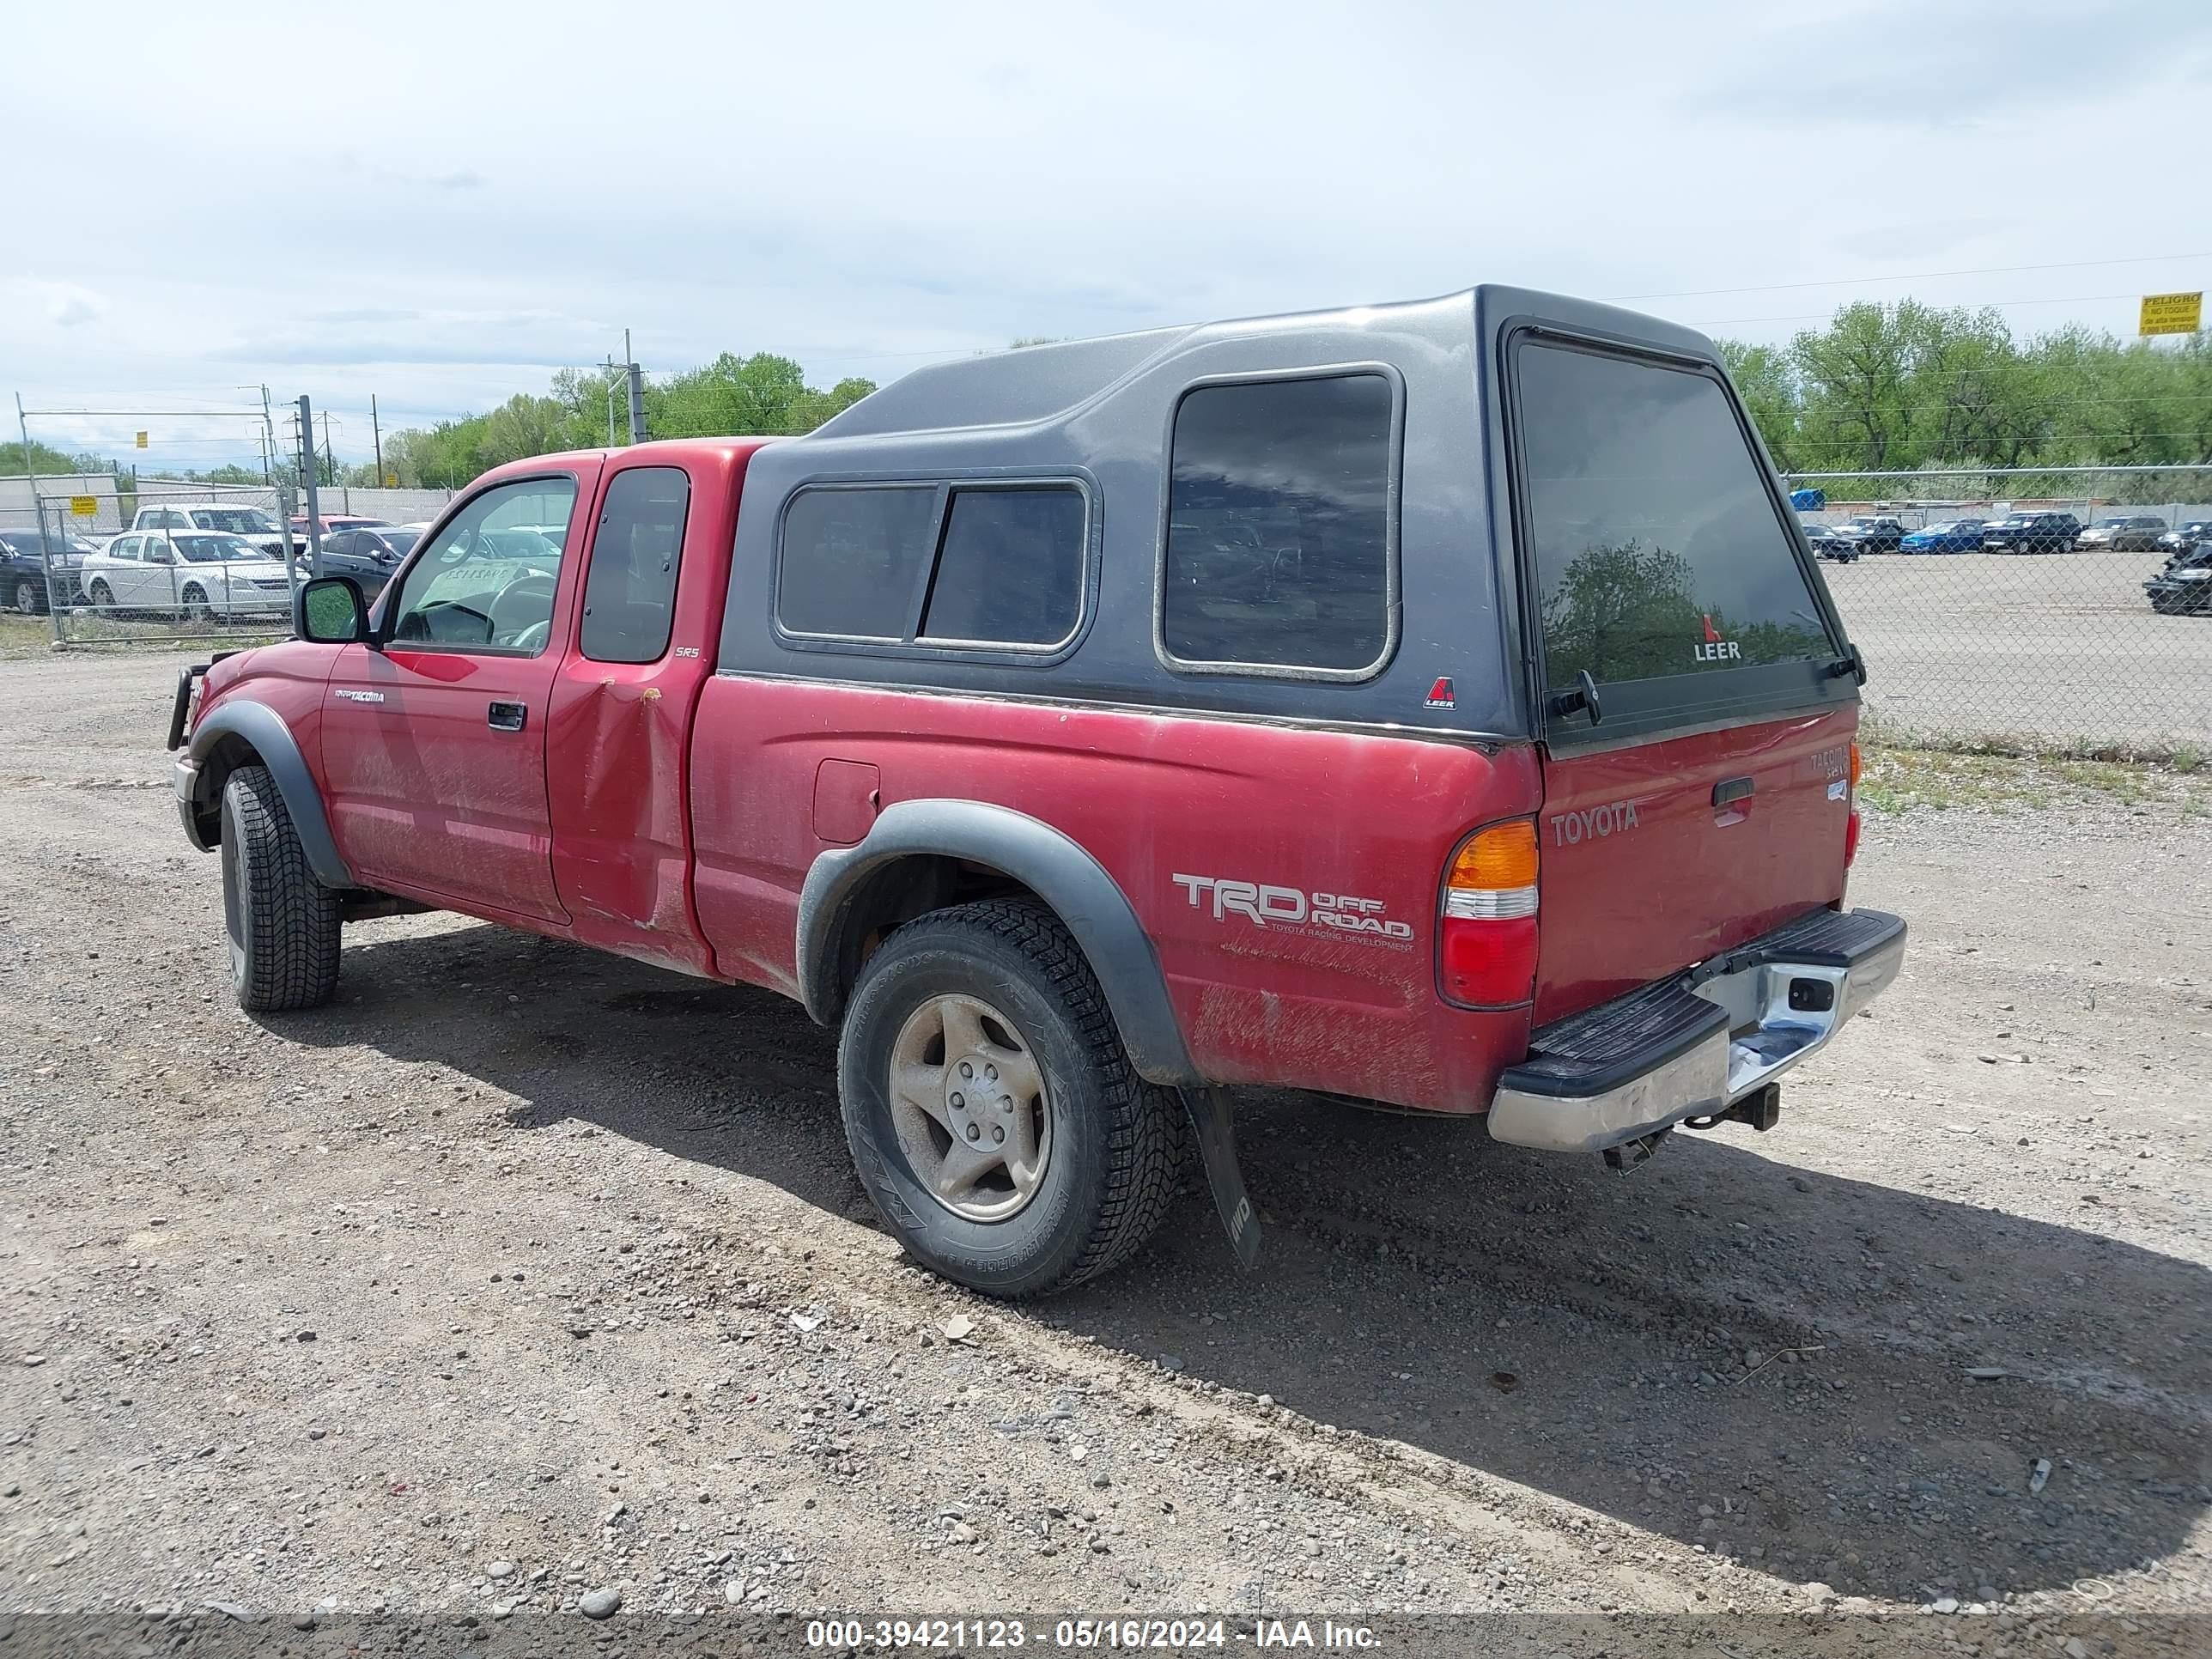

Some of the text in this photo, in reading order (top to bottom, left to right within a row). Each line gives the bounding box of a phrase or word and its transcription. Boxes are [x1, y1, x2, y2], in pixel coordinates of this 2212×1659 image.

[2143, 295, 2200, 305] PELIGRO
[675, 647, 700, 658] SR5
[1694, 641, 1741, 660] LEER
[1550, 799, 1639, 848] TOYOTA
[1172, 872, 1387, 929] TRD OFF
[1271, 922, 1415, 953] TOYOTA RACING DEVELOPMENT
[1312, 909, 1414, 941] ROAD
